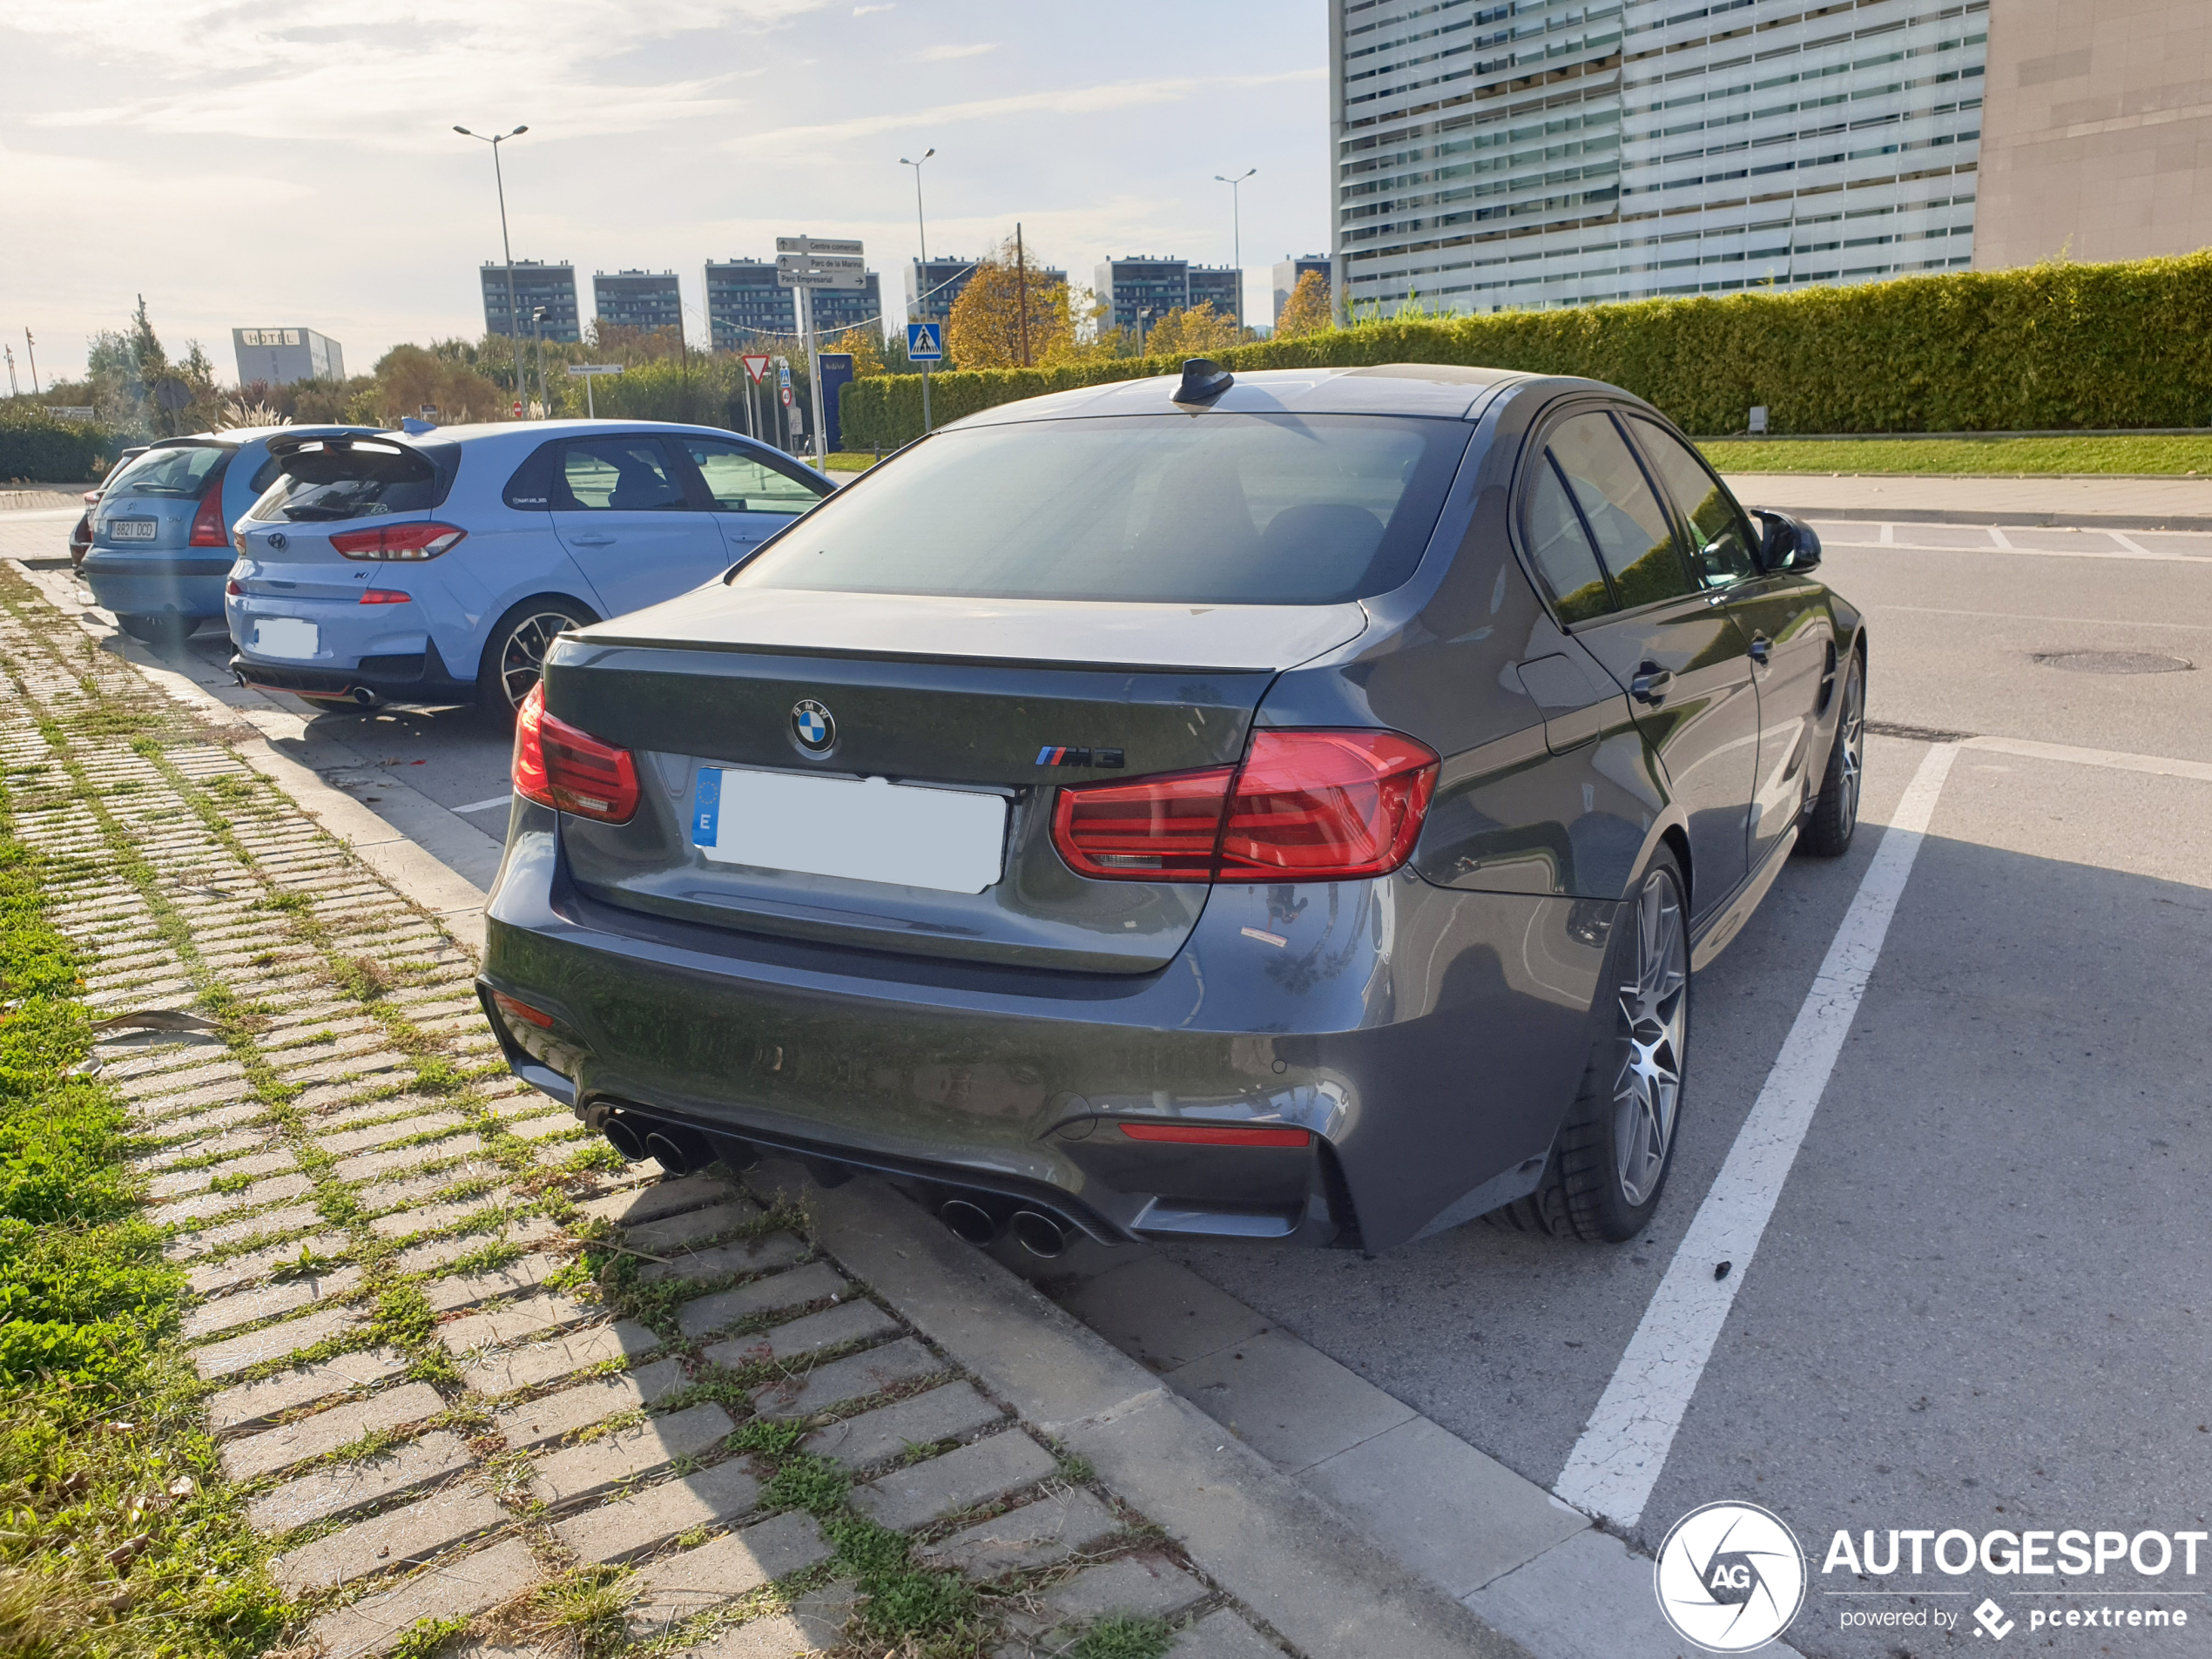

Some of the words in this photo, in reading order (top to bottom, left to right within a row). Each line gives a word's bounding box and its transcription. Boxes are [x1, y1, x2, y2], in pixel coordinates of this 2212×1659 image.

[249, 334, 293, 343] HOTEL
[116, 523, 133, 536] 8821
[137, 523, 153, 536] DCD
[793, 700, 831, 720] BMW
[1054, 746, 1125, 768] M3
[699, 813, 711, 830] E
